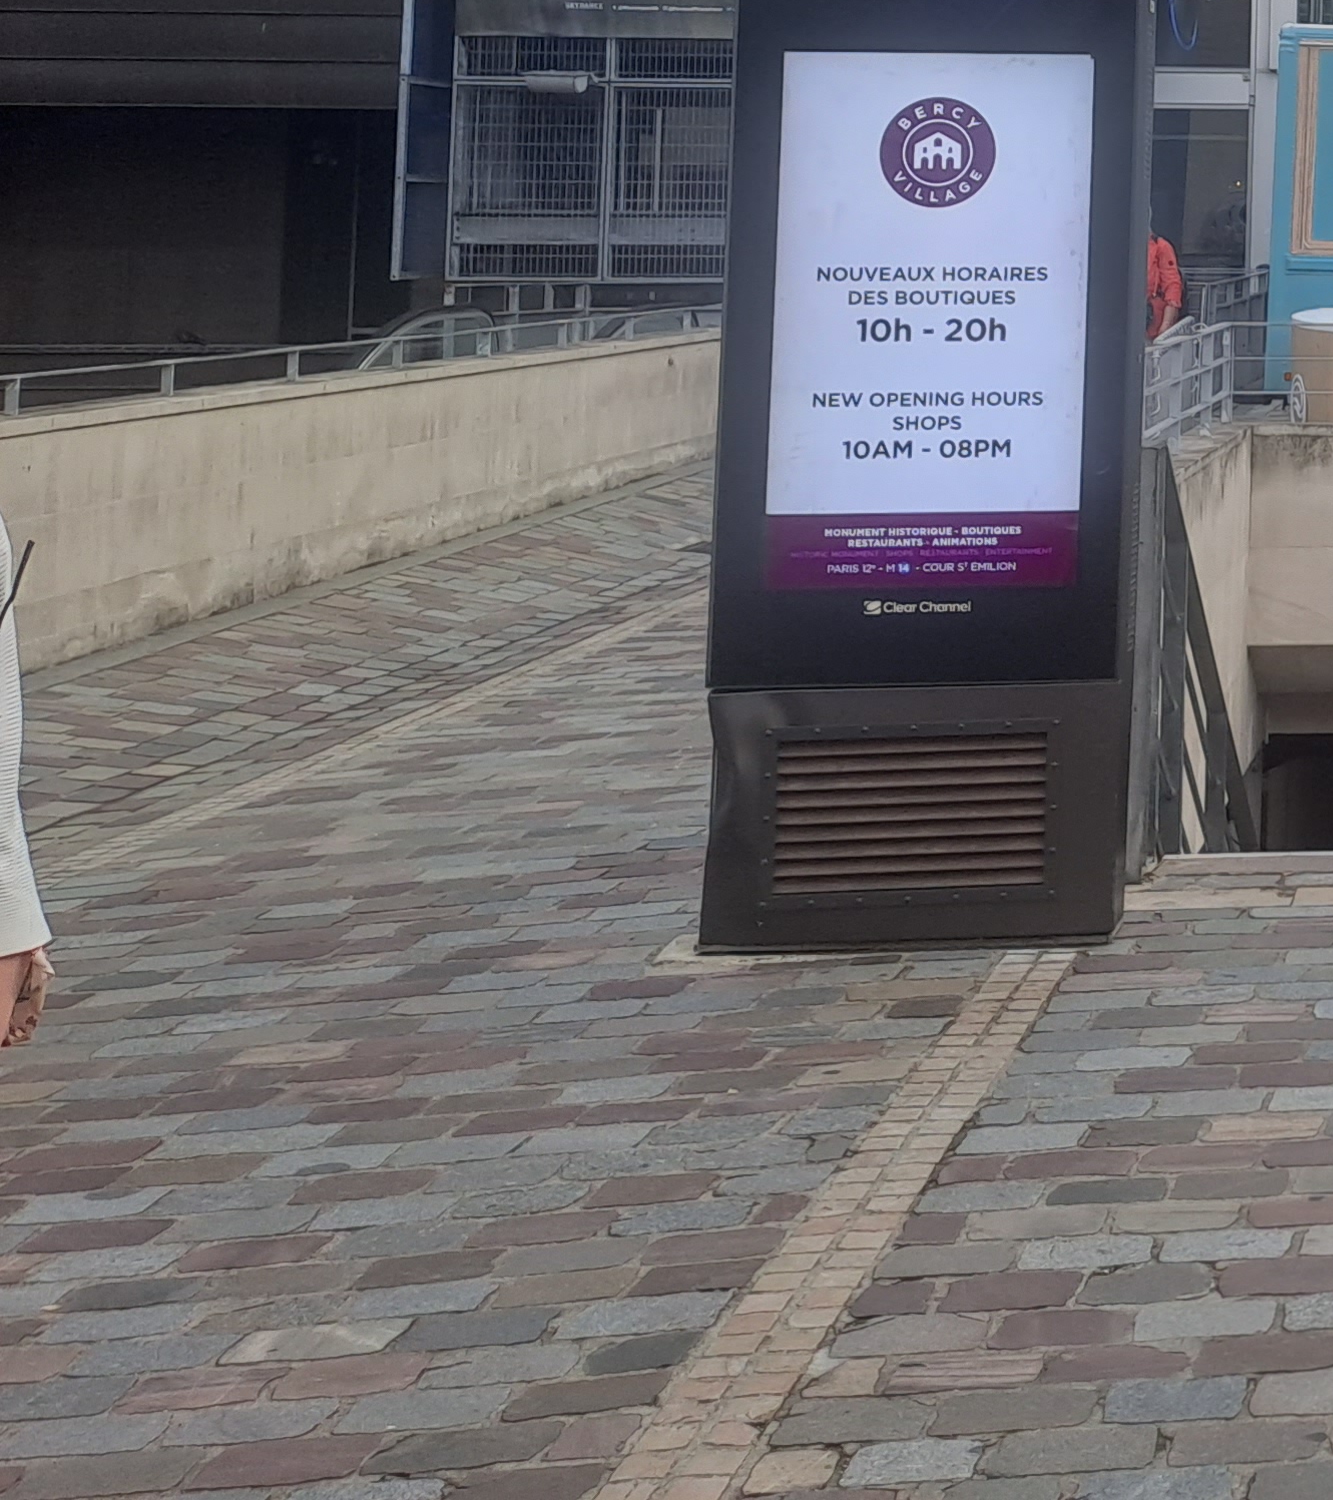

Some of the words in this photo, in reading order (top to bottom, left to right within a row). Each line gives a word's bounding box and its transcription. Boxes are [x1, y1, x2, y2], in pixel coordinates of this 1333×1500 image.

[897, 102, 982, 132] BERCY
[892, 168, 982, 203] VILLAGE
[816, 266, 935, 282] NOUVEAUX
[942, 266, 1048, 281] HORAIRES
[848, 290, 888, 306] DES
[895, 290, 1016, 305] BOUTIQUES
[855, 318, 912, 342] 10h
[944, 317, 1007, 342] 20h
[812, 393, 862, 408] NEW
[869, 392, 965, 408] OPENING
[971, 391, 1043, 407] HOURS
[892, 415, 962, 431] SHOPS
[842, 440, 913, 459] 10AM
[939, 439, 1012, 458] 08PM
[824, 528, 886, 537] MONUMENT
[888, 526, 953, 537] HISTORIQUE
[961, 526, 1021, 535] BOUTIQUES
[847, 538, 923, 548] RESTAURANTS
[932, 537, 998, 547] ANIMATIONS
[827, 564, 859, 573] PARIS
[886, 564, 895, 573] M
[923, 562, 954, 572] COUR
[884, 602, 917, 614] Clear
[919, 601, 972, 614] Channel
